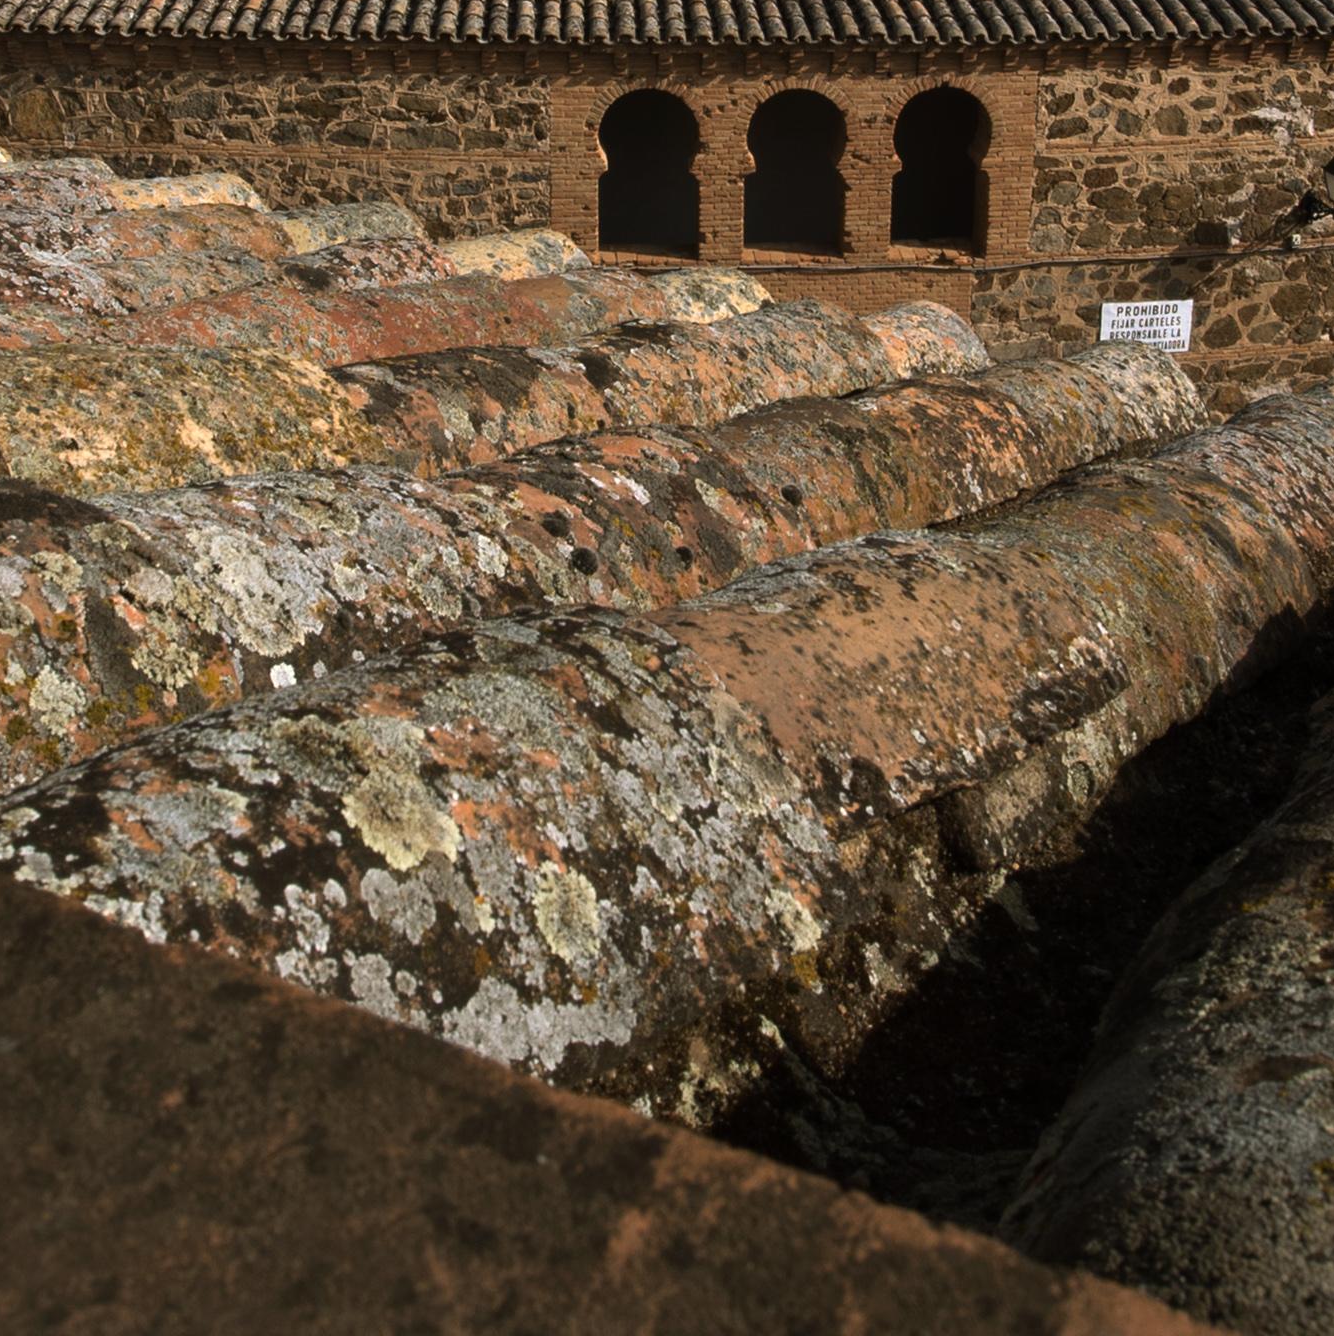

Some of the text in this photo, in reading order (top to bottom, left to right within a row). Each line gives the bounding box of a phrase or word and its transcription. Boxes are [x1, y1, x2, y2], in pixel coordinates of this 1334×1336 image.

[1117, 304, 1178, 317] PROHIBIDO
[1111, 316, 1182, 329] FIJAR CARTELES
[1109, 328, 1181, 340] RESPONSABLE LA
